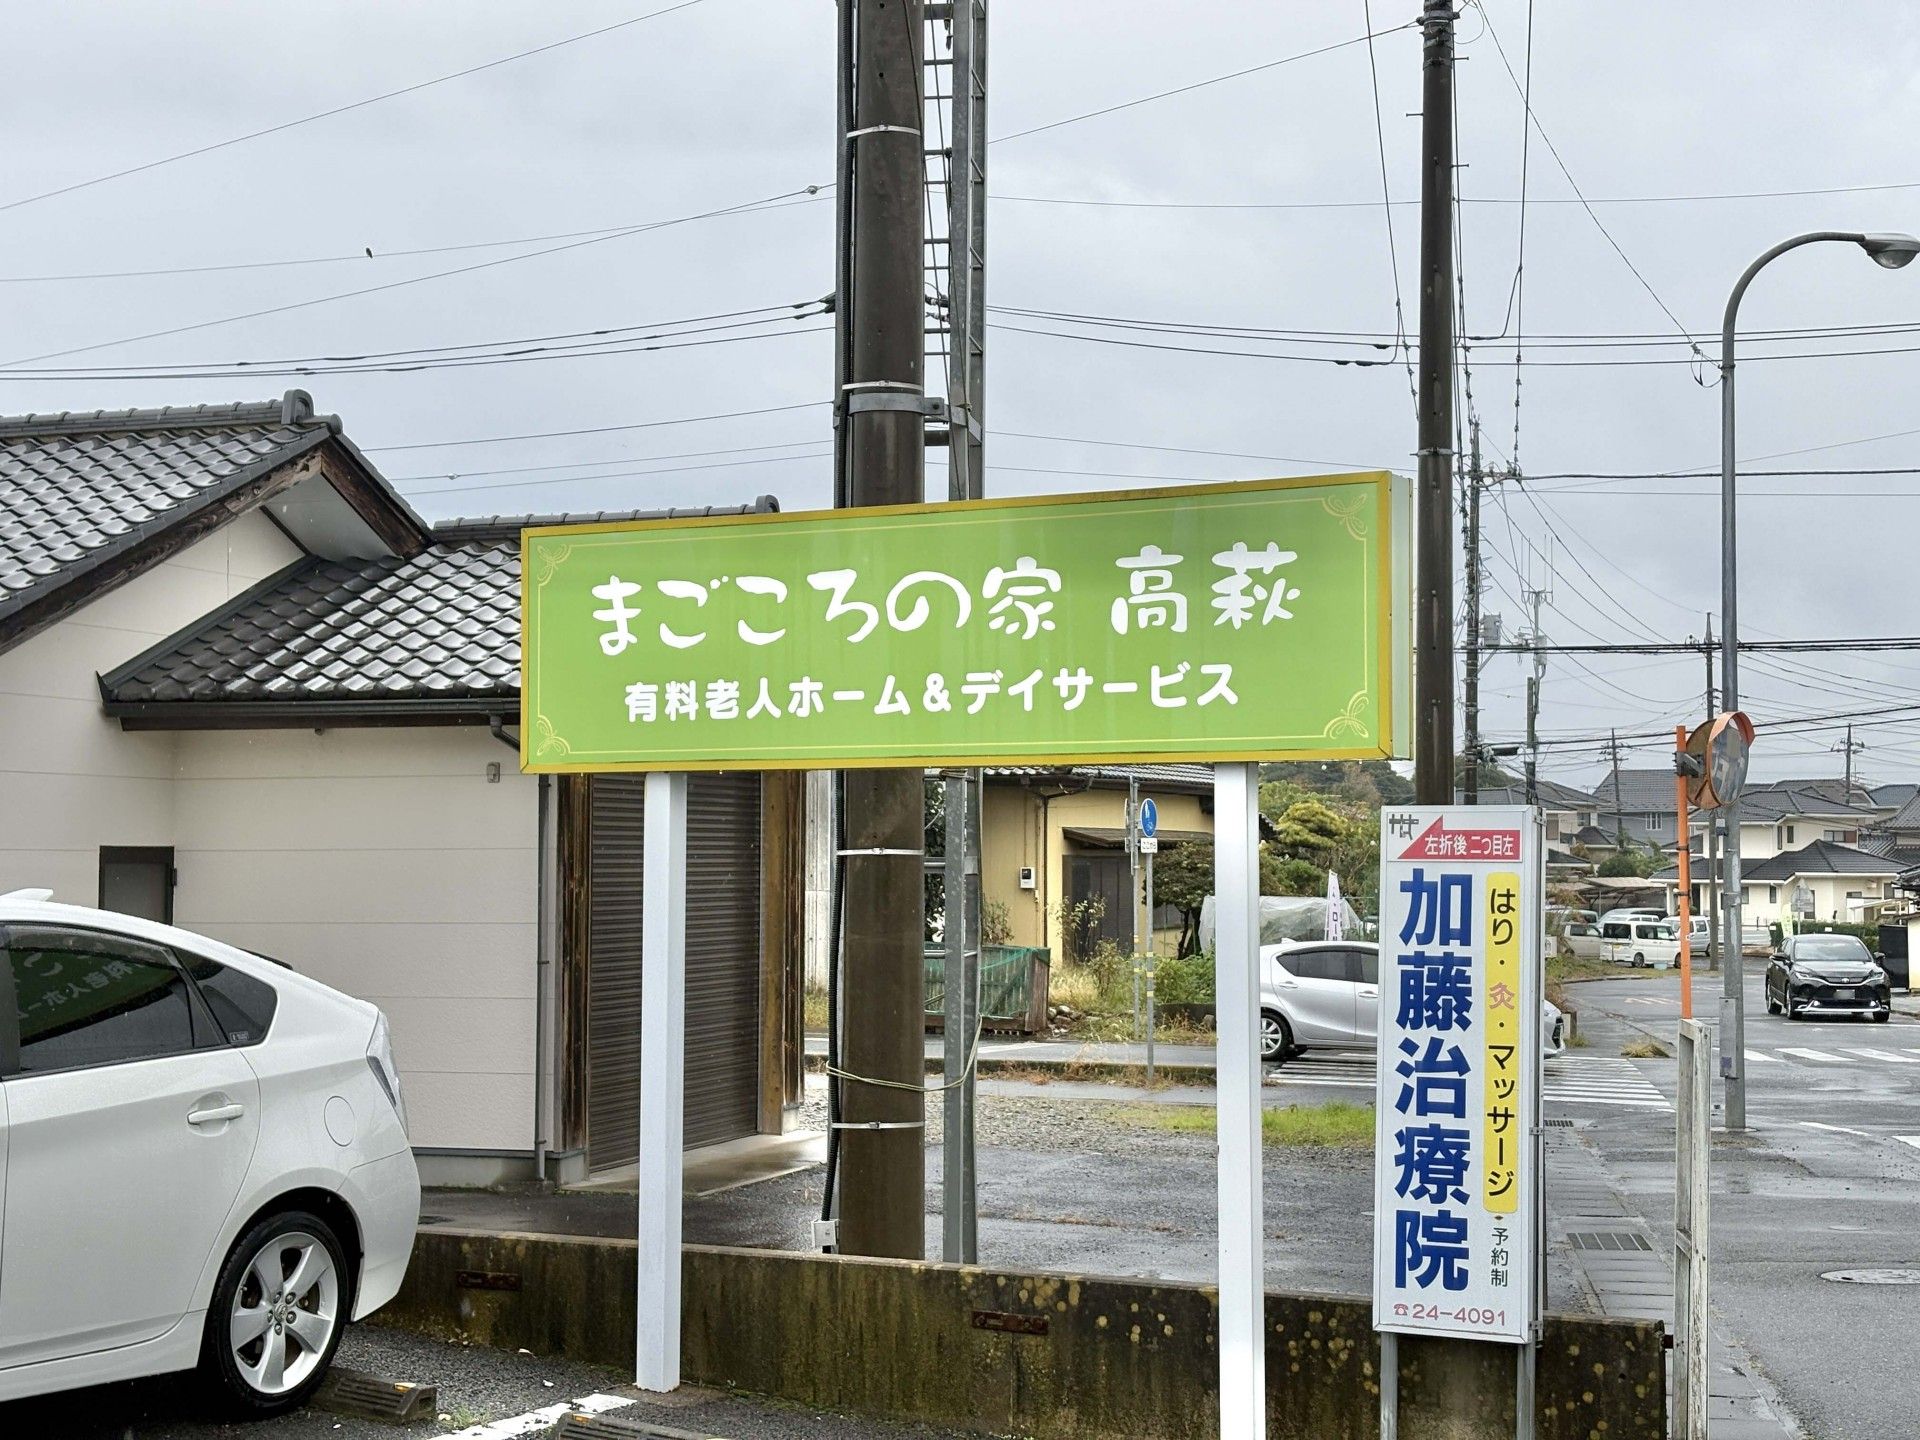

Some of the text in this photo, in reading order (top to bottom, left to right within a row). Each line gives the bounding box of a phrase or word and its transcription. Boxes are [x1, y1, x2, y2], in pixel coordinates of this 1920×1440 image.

[592, 541, 1301, 656] まごころの家 高萩
[624, 661, 1239, 723] 有料老人ホーム&デイサービス
[1424, 833, 1514, 856] 左折後 二つ目左
[1394, 868, 1473, 1292] 加藤治療院
[1490, 1227, 1509, 1288] 予約制
[1412, 1303, 1506, 1326] 24-4091
